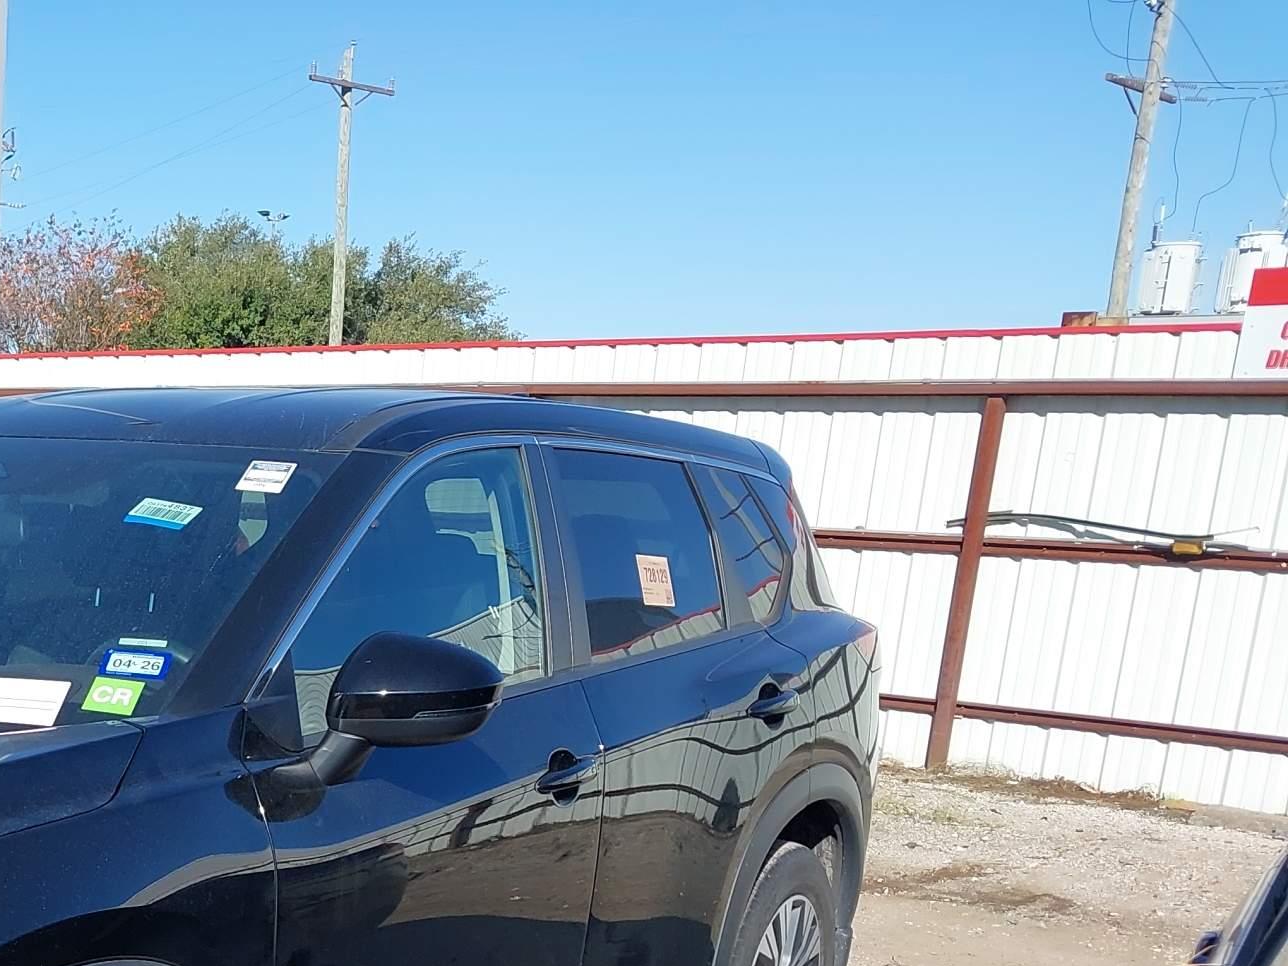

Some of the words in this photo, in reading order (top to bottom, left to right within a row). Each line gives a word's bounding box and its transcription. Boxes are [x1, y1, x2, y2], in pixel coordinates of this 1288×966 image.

[113, 658, 132, 669] 04
[140, 660, 161, 671] 26
[92, 685, 133, 706] CR
